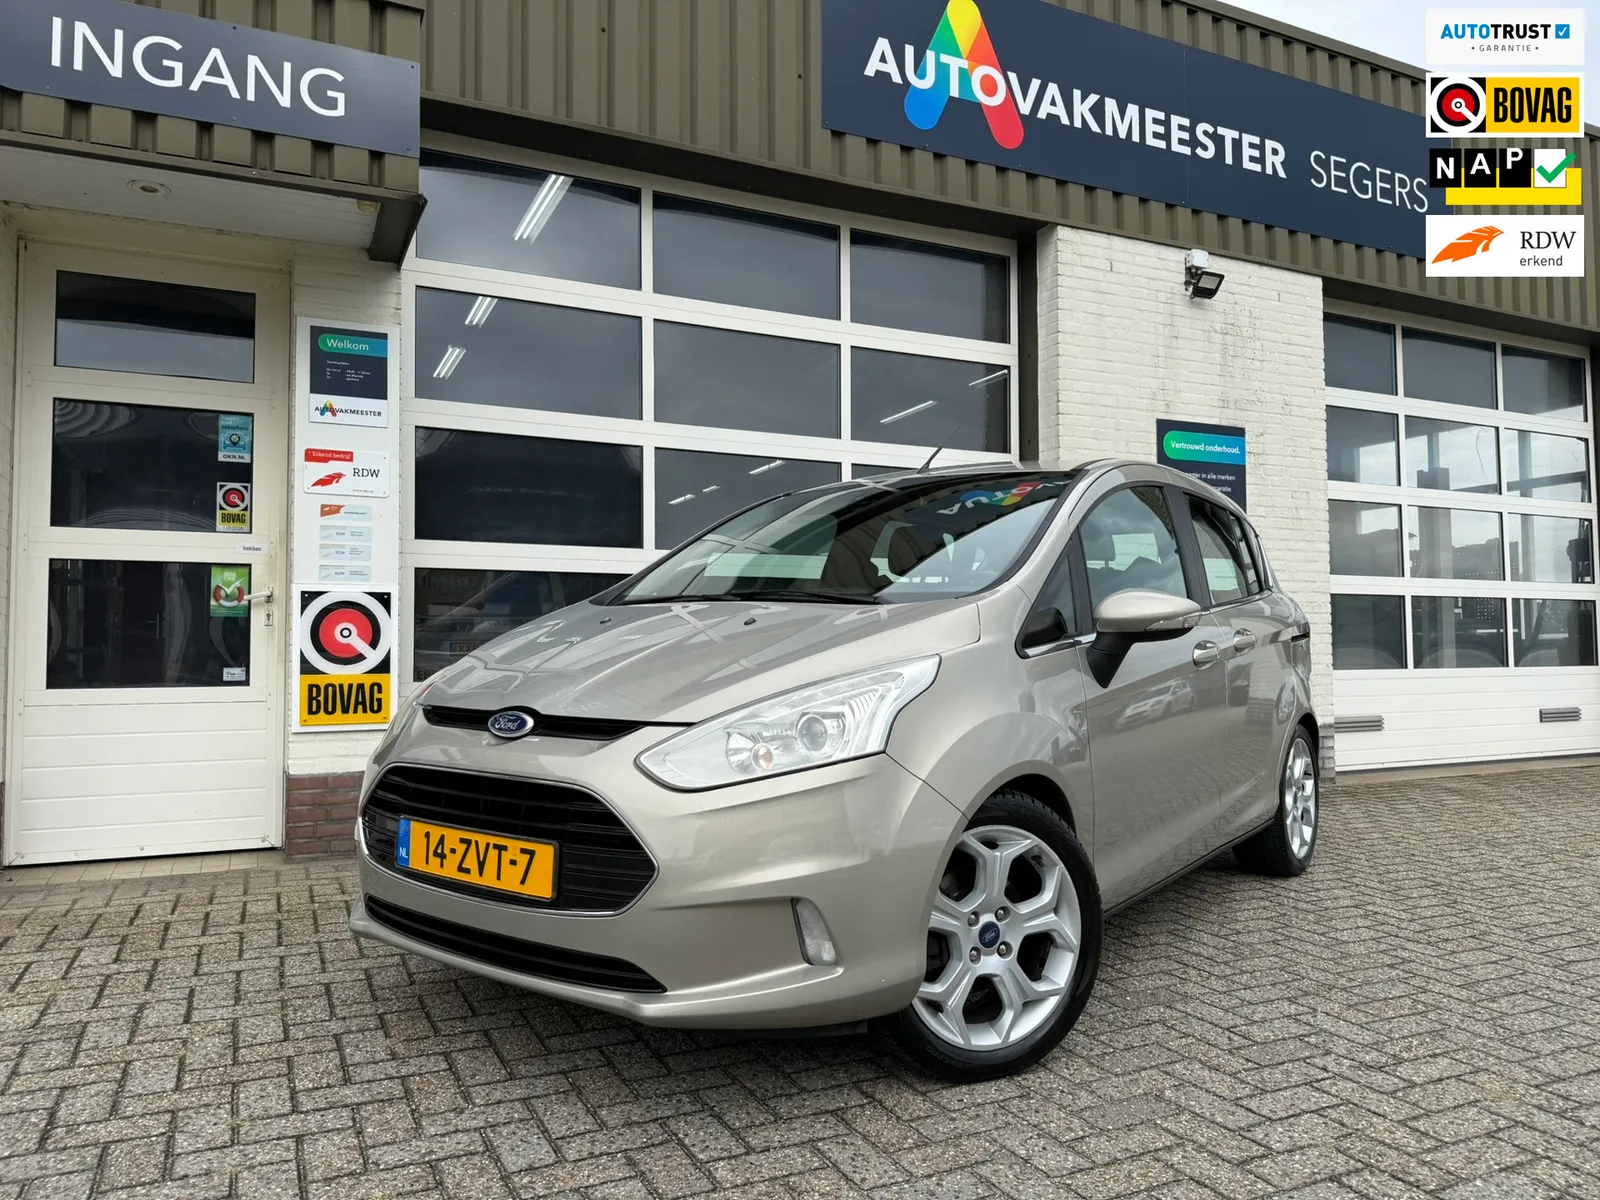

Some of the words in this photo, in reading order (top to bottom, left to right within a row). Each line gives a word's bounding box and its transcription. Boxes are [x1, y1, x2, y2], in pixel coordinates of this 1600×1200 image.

[51, 16, 346, 117] INGANG
[863, 36, 1287, 179] AUTOVAKMEESTER
[1310, 150, 1428, 213] SEGERS
[326, 338, 369, 351] Welkom
[314, 405, 382, 417] AUTOVAKMEESTER
[1170, 440, 1204, 451] Vertrouwd
[1205, 443, 1241, 454] onderhoud.
[352, 467, 380, 478] RDW
[1207, 472, 1216, 480] alle
[221, 512, 246, 524] BOVAG
[307, 682, 383, 716] BOVAG
[495, 715, 521, 730] Ford
[399, 847, 408, 859] NL
[424, 830, 536, 885] 14-ZVT-7
